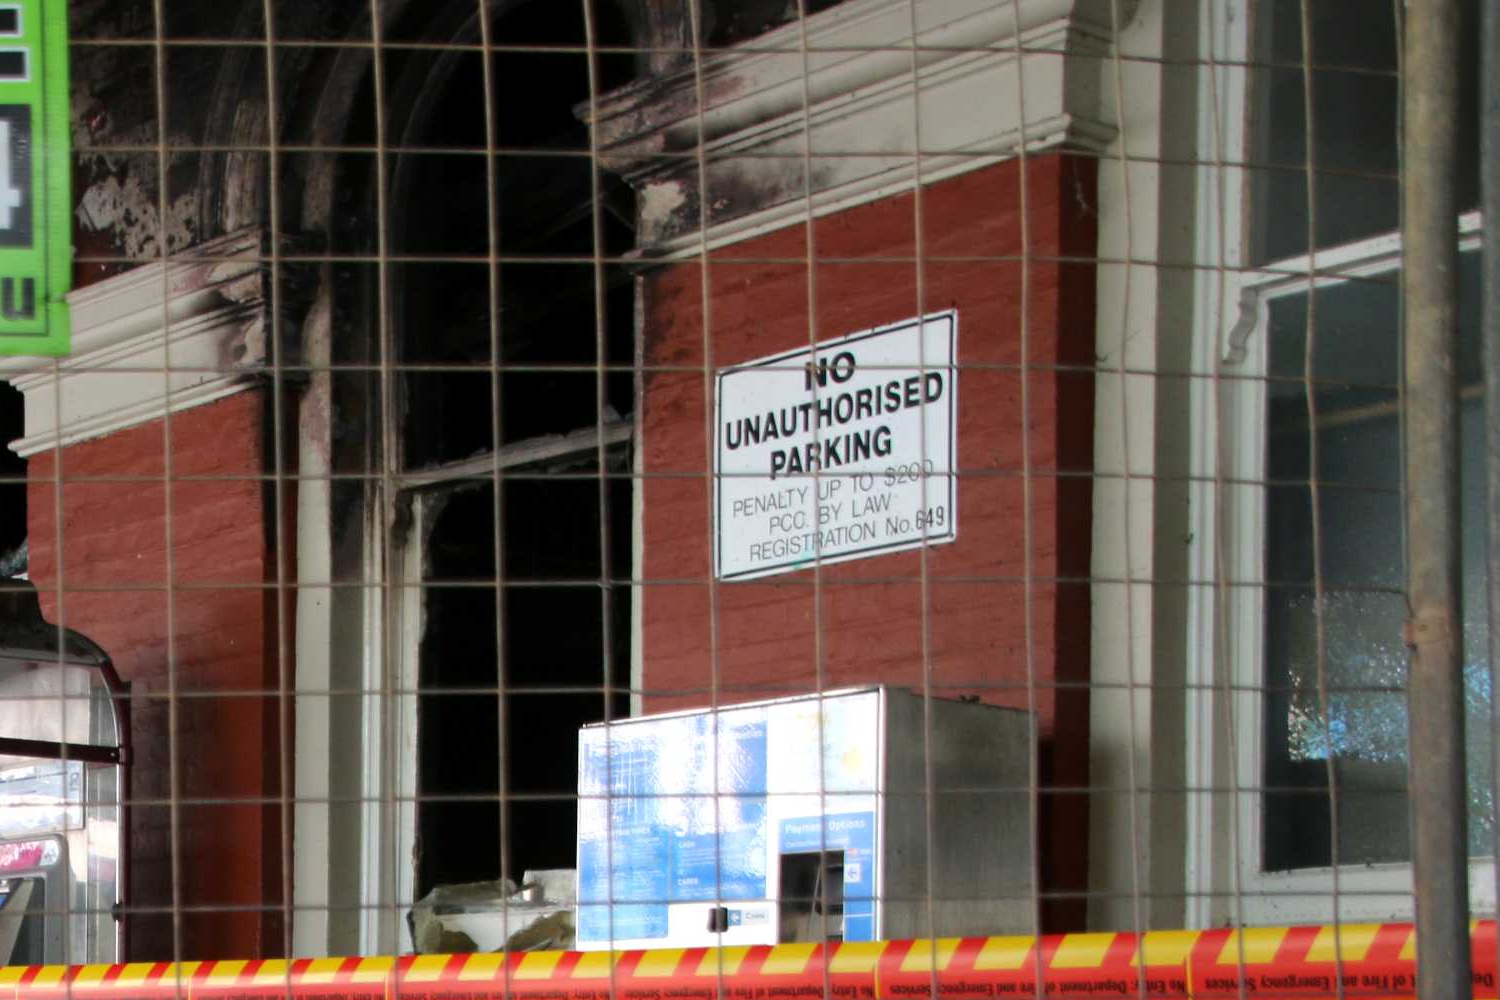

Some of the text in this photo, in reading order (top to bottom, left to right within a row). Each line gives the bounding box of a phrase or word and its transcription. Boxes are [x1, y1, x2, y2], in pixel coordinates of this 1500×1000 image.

[804, 351, 857, 392] NO
[725, 371, 944, 450] UNAUTHORISED
[770, 425, 893, 481] PARKING
[732, 458, 934, 519] PENALTY UP TO $200
[817, 502, 843, 526] BY
[851, 491, 893, 520] LAW
[749, 505, 945, 562] REGISTRATION No. 649
[1061, 979, 1129, 994] Department
[1204, 977, 1258, 992] Sevices
[1262, 975, 1330, 991] Emergency
[1363, 975, 1389, 990] Fire
[1394, 975, 1408, 990] of
